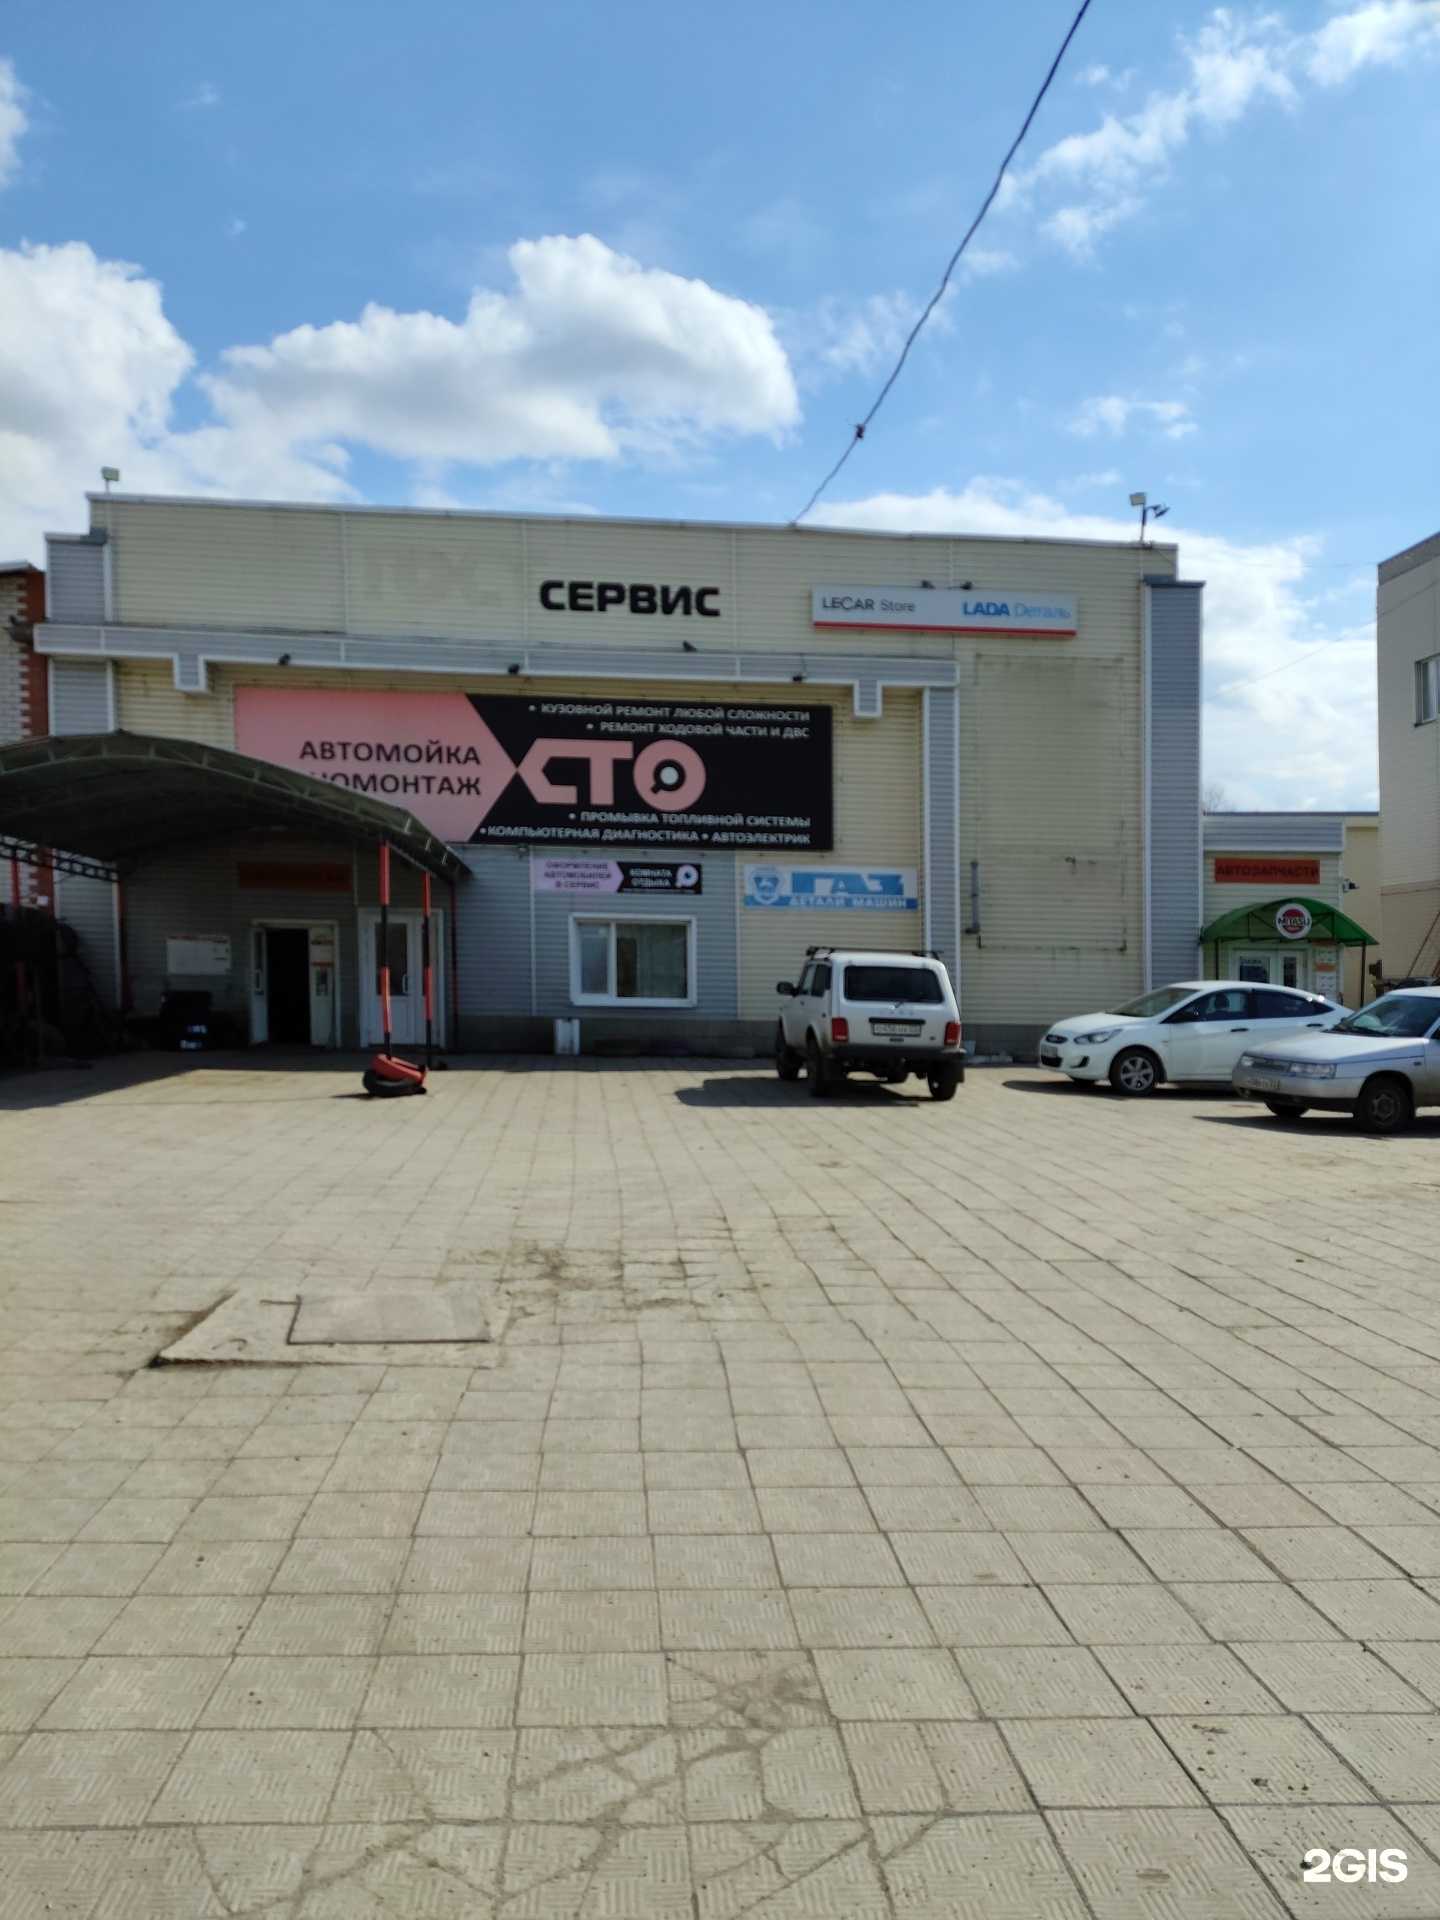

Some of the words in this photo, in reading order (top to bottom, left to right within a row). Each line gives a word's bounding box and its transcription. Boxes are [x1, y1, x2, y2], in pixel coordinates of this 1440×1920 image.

[540, 580, 721, 617] СЕРВИС
[823, 596, 875, 610] LECAR
[880, 598, 917, 612] Store
[963, 601, 1010, 616] LADA
[541, 702, 613, 715] КУЗОВНОЙ
[615, 705, 670, 717] РЕМОНТ
[673, 706, 725, 718] ЛЮБОЙ
[726, 709, 810, 720] СЛОЖНОСТИ
[600, 721, 654, 733] РЕМОНТ
[658, 722, 723, 736] ХОДОВОЙ
[725, 725, 768, 736] ЧАСТИ
[770, 726, 780, 737] И
[782, 726, 810, 739] ДВС
[299, 739, 481, 765] АВТОМОЙКА
[311, 772, 481, 796] ОМОНТАЖ
[580, 811, 659, 824] ПРОМЫВКА
[662, 812, 744, 826] ТОПЛИВНОЙ
[746, 815, 811, 828] СИСТЕМЫ
[487, 825, 600, 839] КОМПЬЮТЕРНАЯ
[601, 828, 699, 842] ДИАГНОСТИКА
[711, 832, 811, 845] АВТОЭЛЕКТРИК
